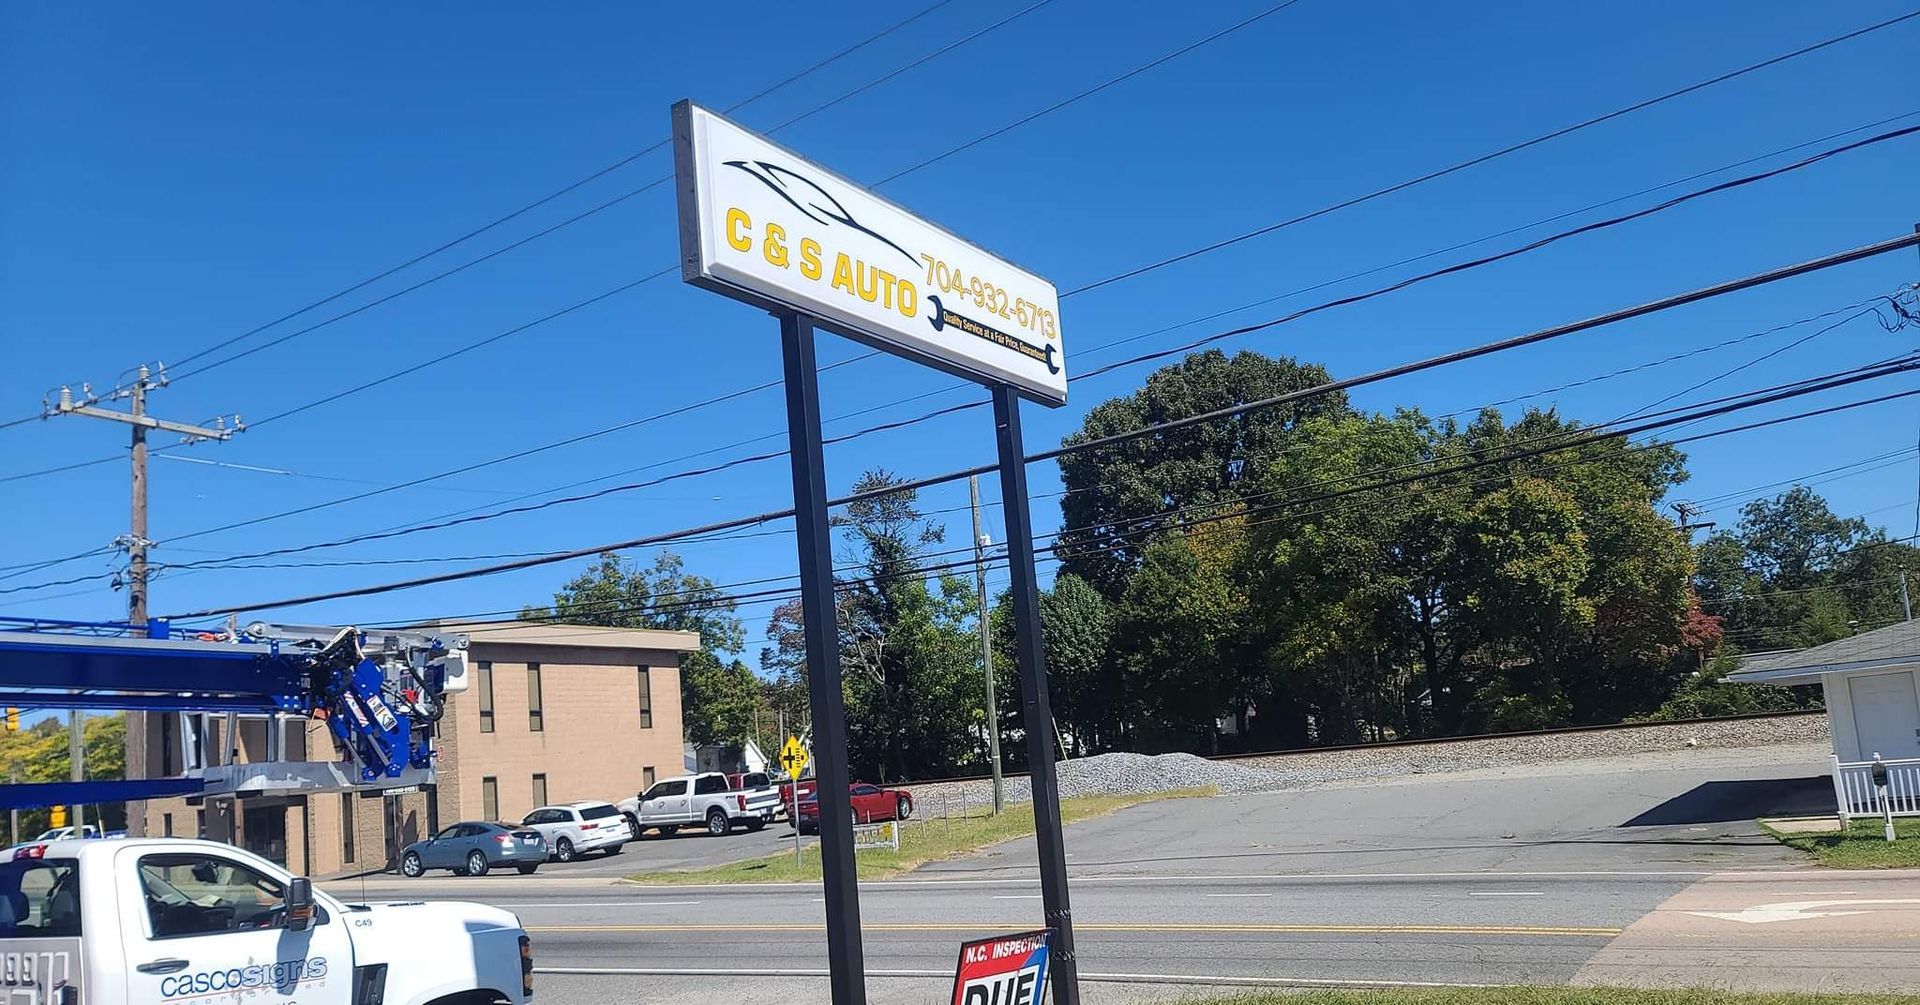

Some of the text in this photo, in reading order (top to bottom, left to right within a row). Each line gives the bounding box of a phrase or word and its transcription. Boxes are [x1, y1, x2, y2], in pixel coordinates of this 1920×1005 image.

[726, 207, 917, 318] C & S AUTO
[920, 253, 1056, 339] 704-932-6713
[943, 312, 962, 329] Quality
[963, 319, 983, 336] Service
[995, 332, 1005, 344] Fair
[1005, 336, 1019, 352] Price,
[966, 933, 1047, 963] N.C. INSPECTION
[964, 972, 1035, 1005] DUE
